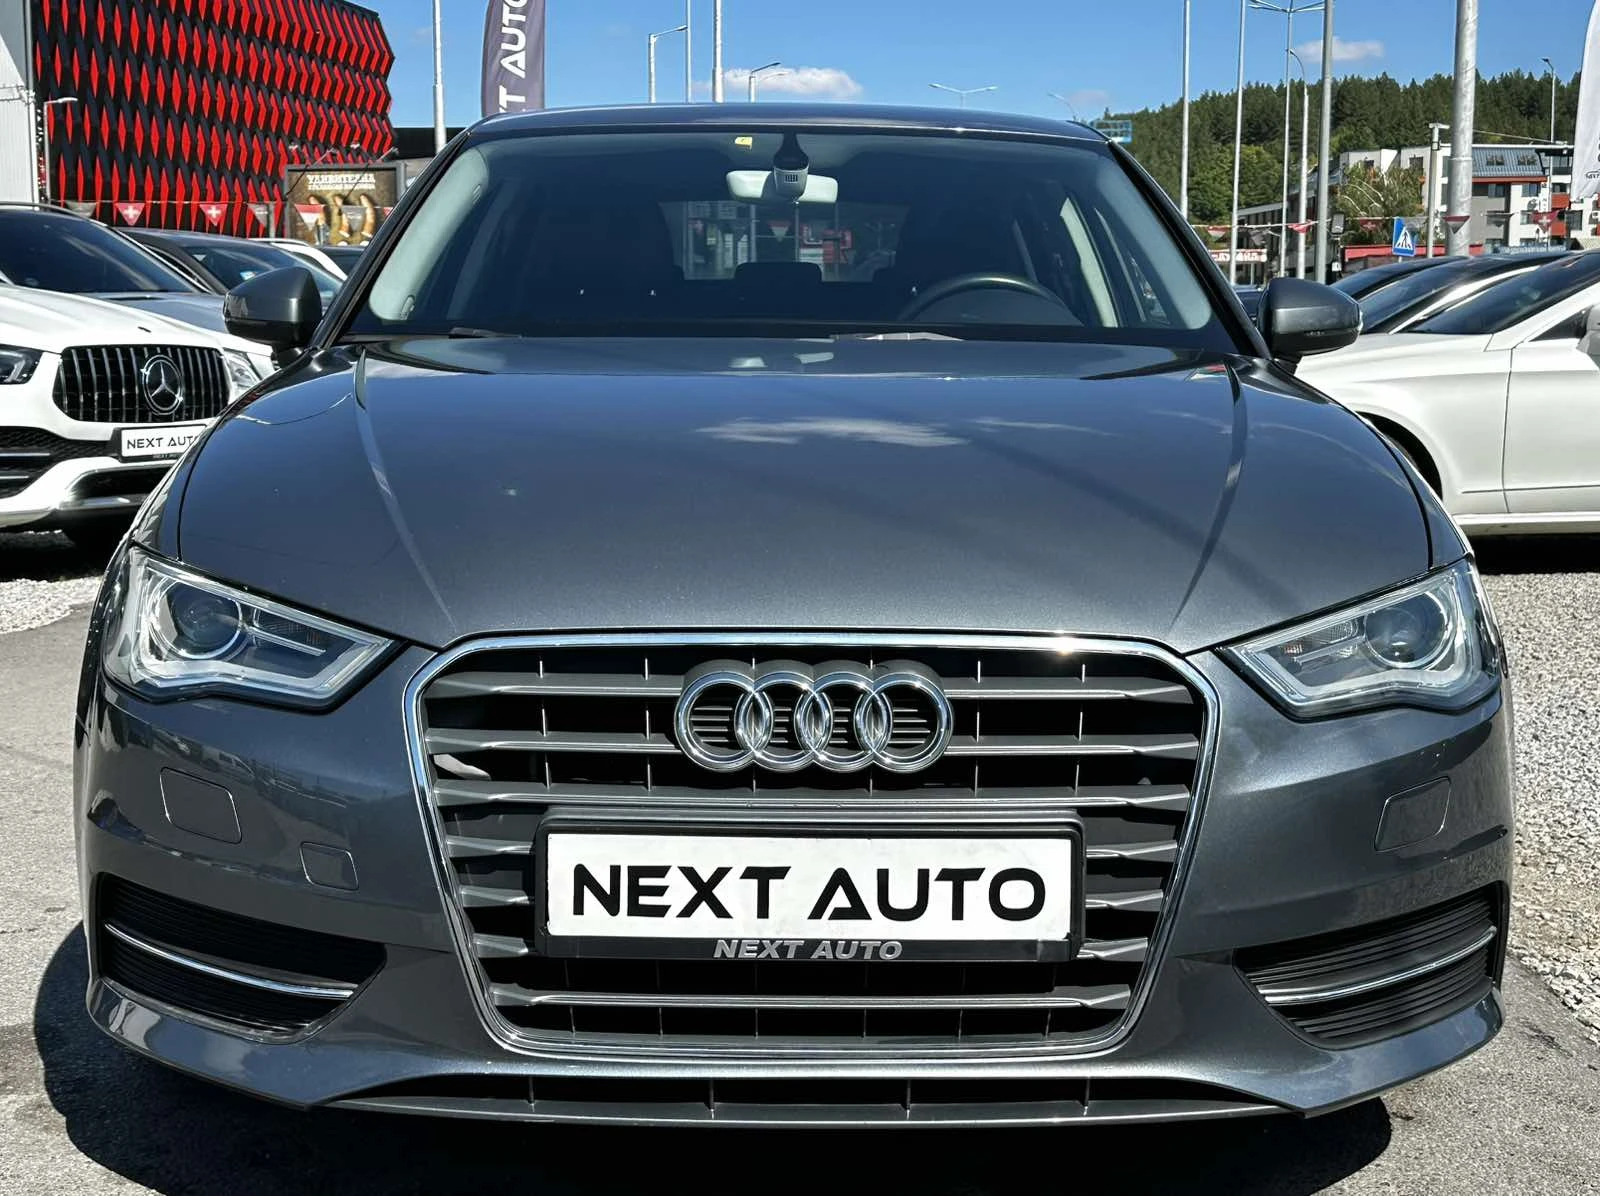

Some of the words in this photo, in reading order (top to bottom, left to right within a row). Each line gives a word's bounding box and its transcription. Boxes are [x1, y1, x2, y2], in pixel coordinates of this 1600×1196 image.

[127, 437, 164, 449] NEXT
[573, 863, 792, 919] NEXT
[807, 867, 1046, 922] AUTO
[713, 939, 805, 959] NEXT
[810, 940, 903, 960] AUTO
